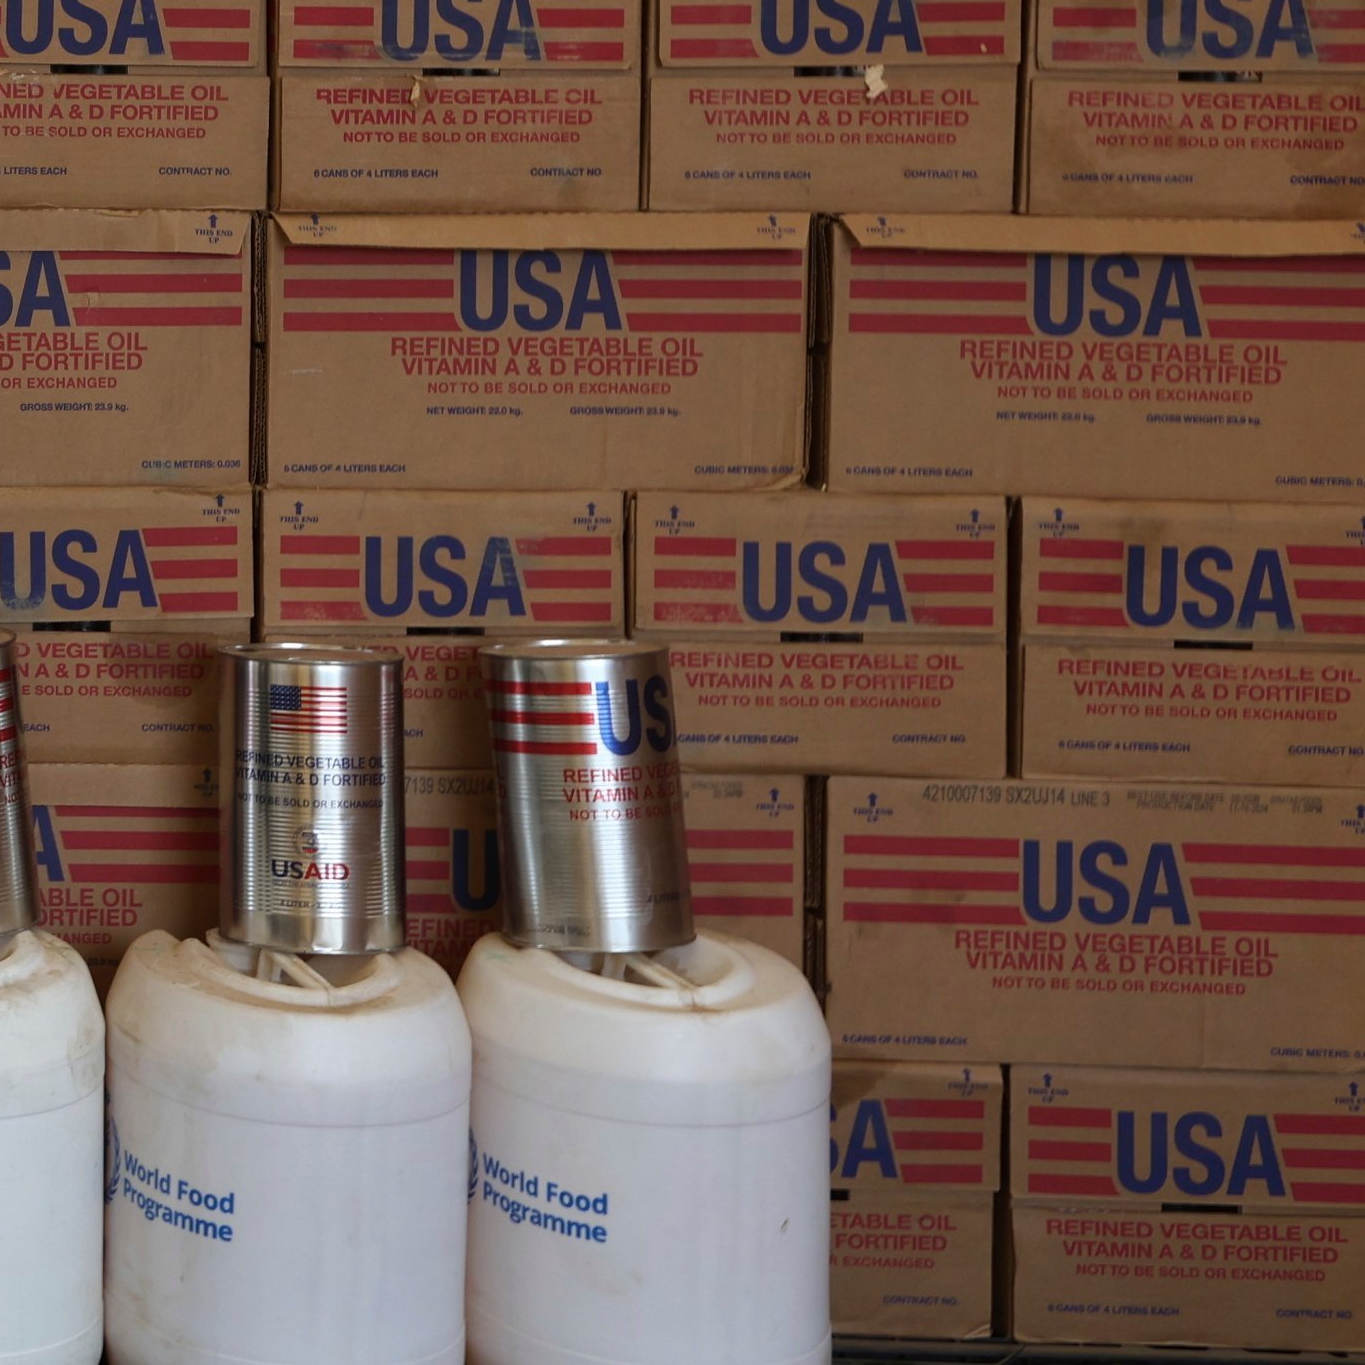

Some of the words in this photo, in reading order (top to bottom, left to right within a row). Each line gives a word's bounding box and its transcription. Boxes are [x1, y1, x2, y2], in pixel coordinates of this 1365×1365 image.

[20, 402, 53, 412] GROSS
[54, 402, 93, 412] WEIGHT:
[94, 402, 113, 412] 23.9
[114, 402, 129, 414] kg.
[743, 542, 907, 623] USA
[595, 674, 677, 756] US
[236, 750, 283, 766] REFINED
[288, 754, 365, 769] VEGETABLE
[236, 766, 281, 784] VITAMIN
[282, 770, 293, 785] A
[295, 771, 306, 785] &
[309, 771, 320, 786] D
[323, 771, 386, 787] FORTIFIED
[562, 767, 642, 784] REFINED
[267, 796, 280, 806] BE
[283, 797, 310, 808] SOLD
[313, 798, 328, 809] OR
[330, 798, 384, 809] EXCHANGED
[562, 787, 639, 804] VITAMIN
[643, 787, 654, 801] A
[570, 809, 599, 821] NOT
[604, 809, 622, 821] TO
[625, 808, 642, 820] BE
[270, 858, 350, 881] USAID
[1023, 840, 1190, 924] USA
[954, 931, 1067, 951] REFINED
[1074, 933, 1226, 957] VEGETABLE
[1234, 937, 1279, 958] OIL
[1117, 1111, 1285, 1196] USA
[124, 1150, 170, 1195] World
[177, 1180, 235, 1214] Food
[483, 1152, 538, 1198] World
[546, 1181, 608, 1216] Food
[123, 1178, 233, 1241] Programme
[483, 1180, 607, 1243] Programme
